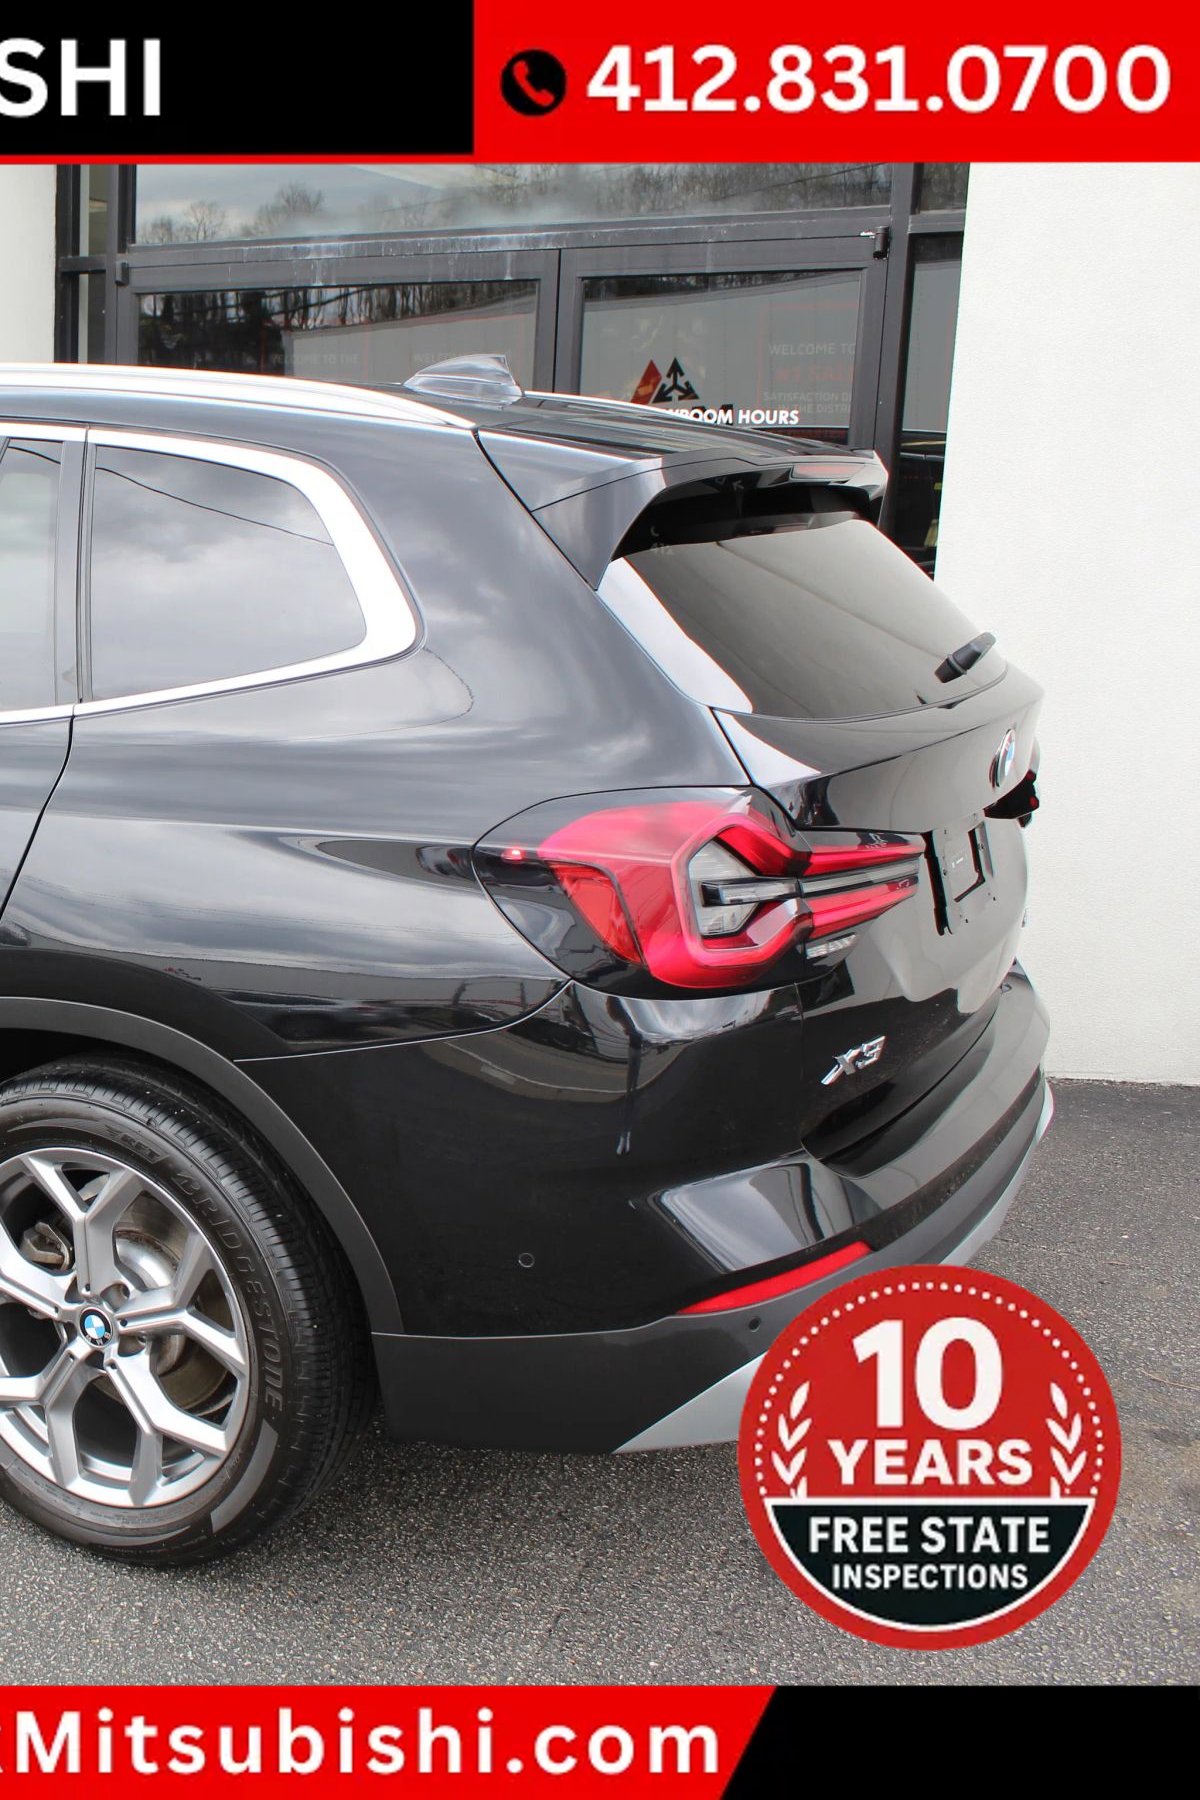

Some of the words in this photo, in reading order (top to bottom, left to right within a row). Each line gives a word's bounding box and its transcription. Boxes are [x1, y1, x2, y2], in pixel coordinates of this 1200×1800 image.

[738, 409, 800, 425] HOURS
[820, 1035, 886, 1086] X3
[172, 1170, 284, 1412] BRIDGESTONE
